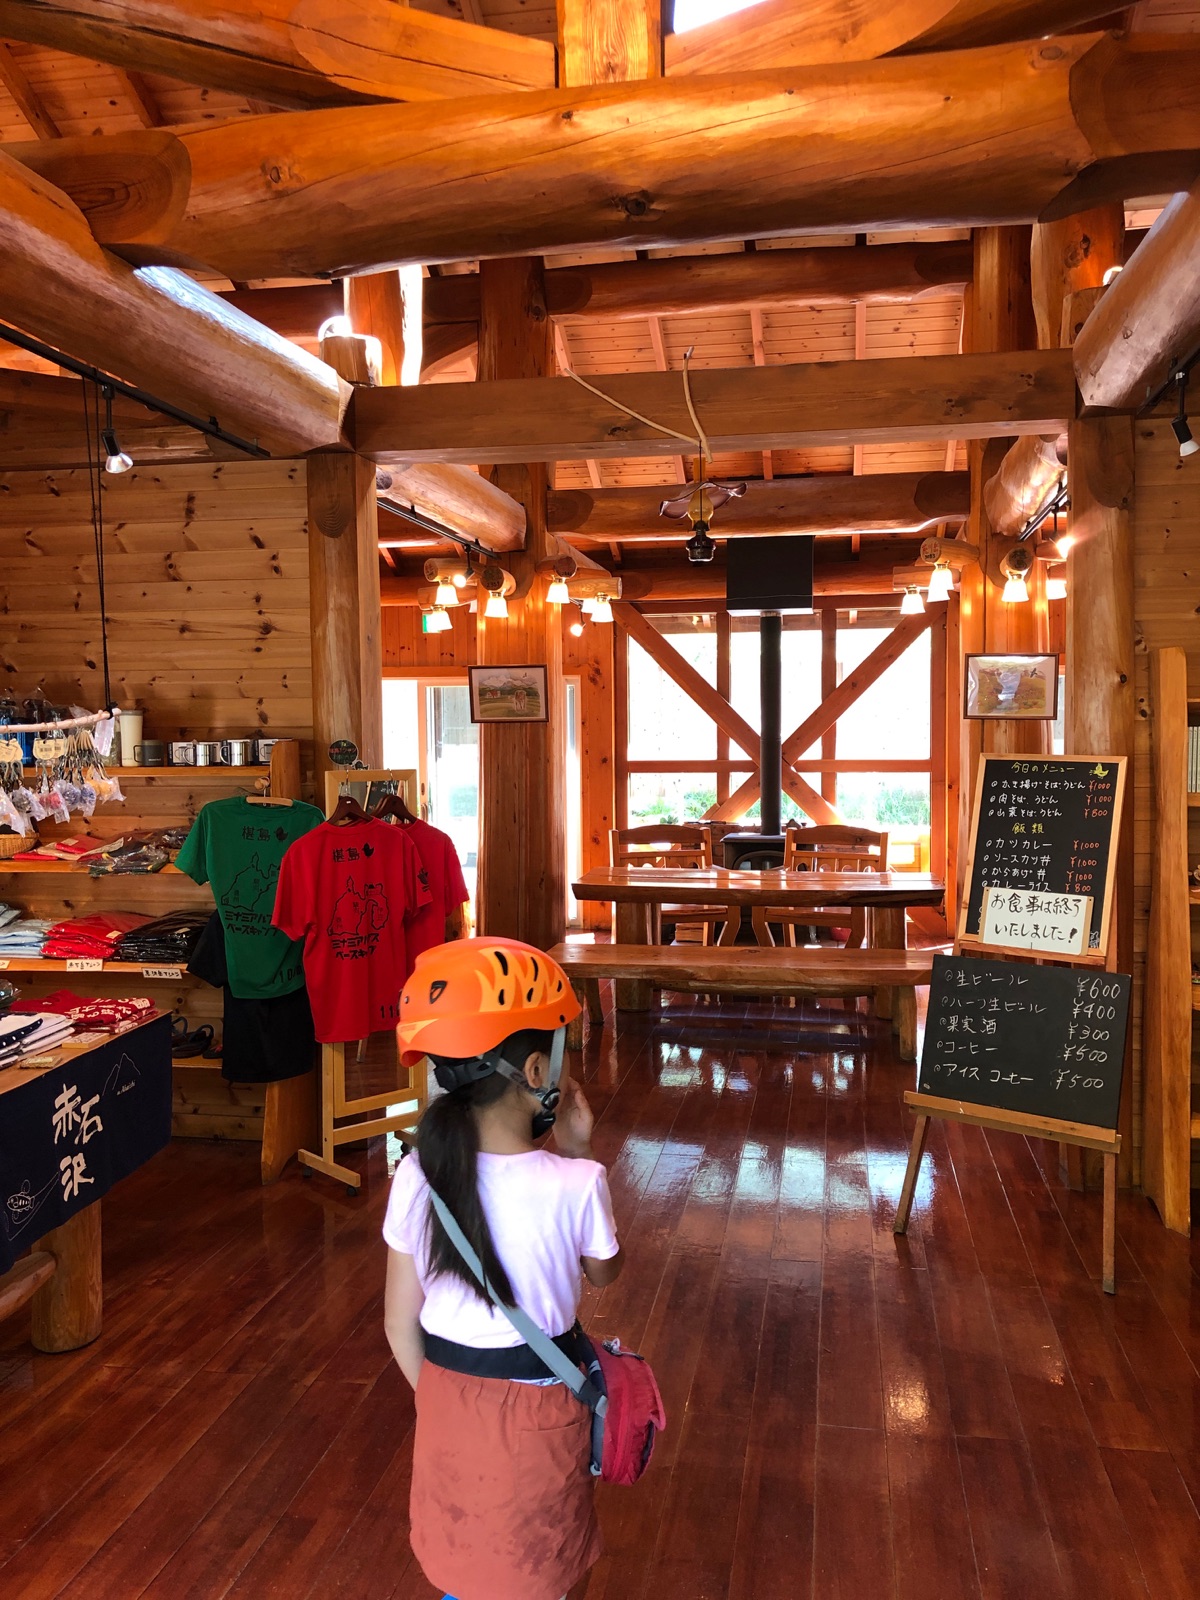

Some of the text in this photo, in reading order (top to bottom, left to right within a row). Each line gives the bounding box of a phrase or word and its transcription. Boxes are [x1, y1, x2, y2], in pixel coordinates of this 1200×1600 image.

[1011, 762, 1075, 774] 今日のメニュー
[1084, 808, 1108, 819] ¥800
[1012, 822, 1044, 834] 飯類
[995, 838, 1052, 850] カツカレー
[994, 853, 1051, 866] ソースカツ丼
[992, 879, 1091, 893] カレーライス ¥800
[990, 893, 1083, 917] お食事は終了
[225, 910, 273, 924] ミナミアルプ
[956, 970, 1121, 999] 生ビール ¥600
[949, 997, 1116, 1020] ハーフ生ビール ¥400
[947, 1015, 1110, 1041] 果実酒 ¥300
[944, 1041, 1108, 1063] コーヒー ¥500
[1056, 1069, 1104, 1090] ¥500
